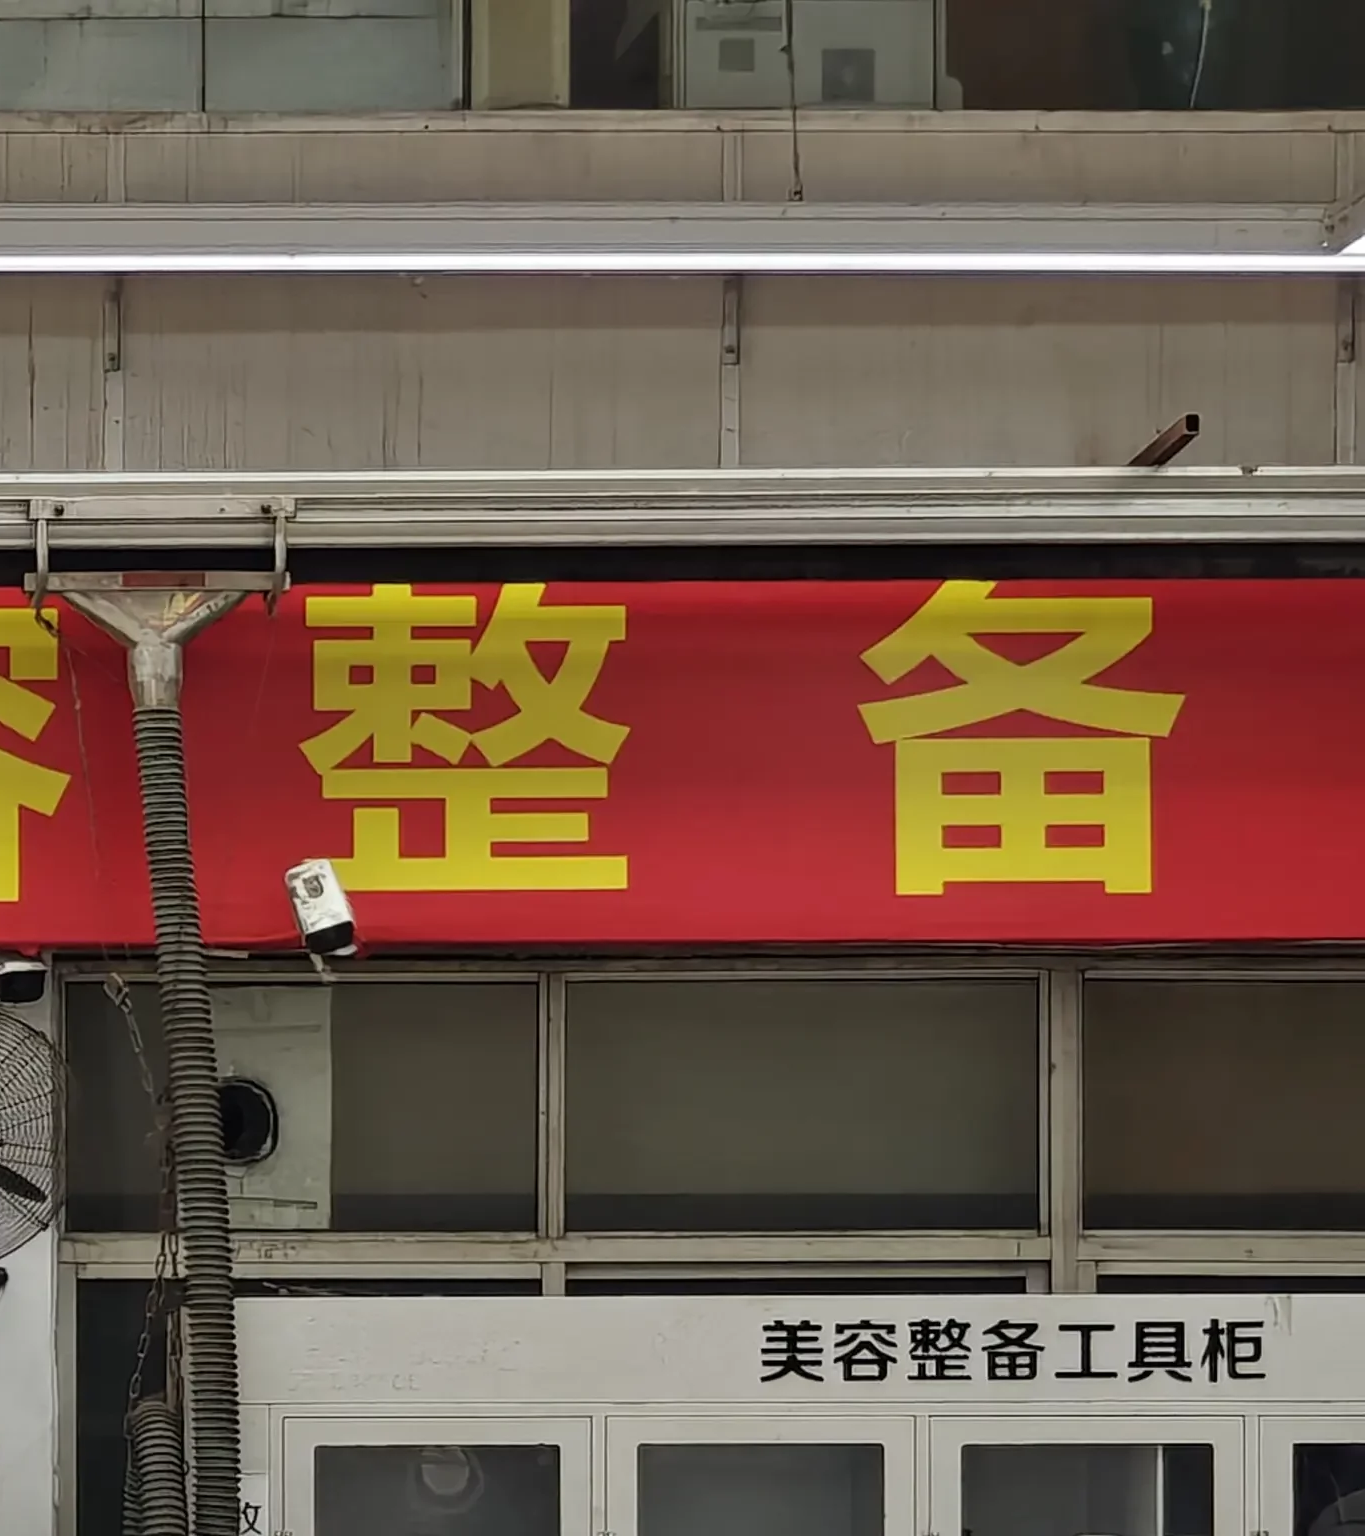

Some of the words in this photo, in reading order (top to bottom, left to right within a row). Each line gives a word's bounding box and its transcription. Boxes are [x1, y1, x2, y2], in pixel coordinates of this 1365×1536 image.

[759, 1318, 1268, 1384] 美容整备工具柜
